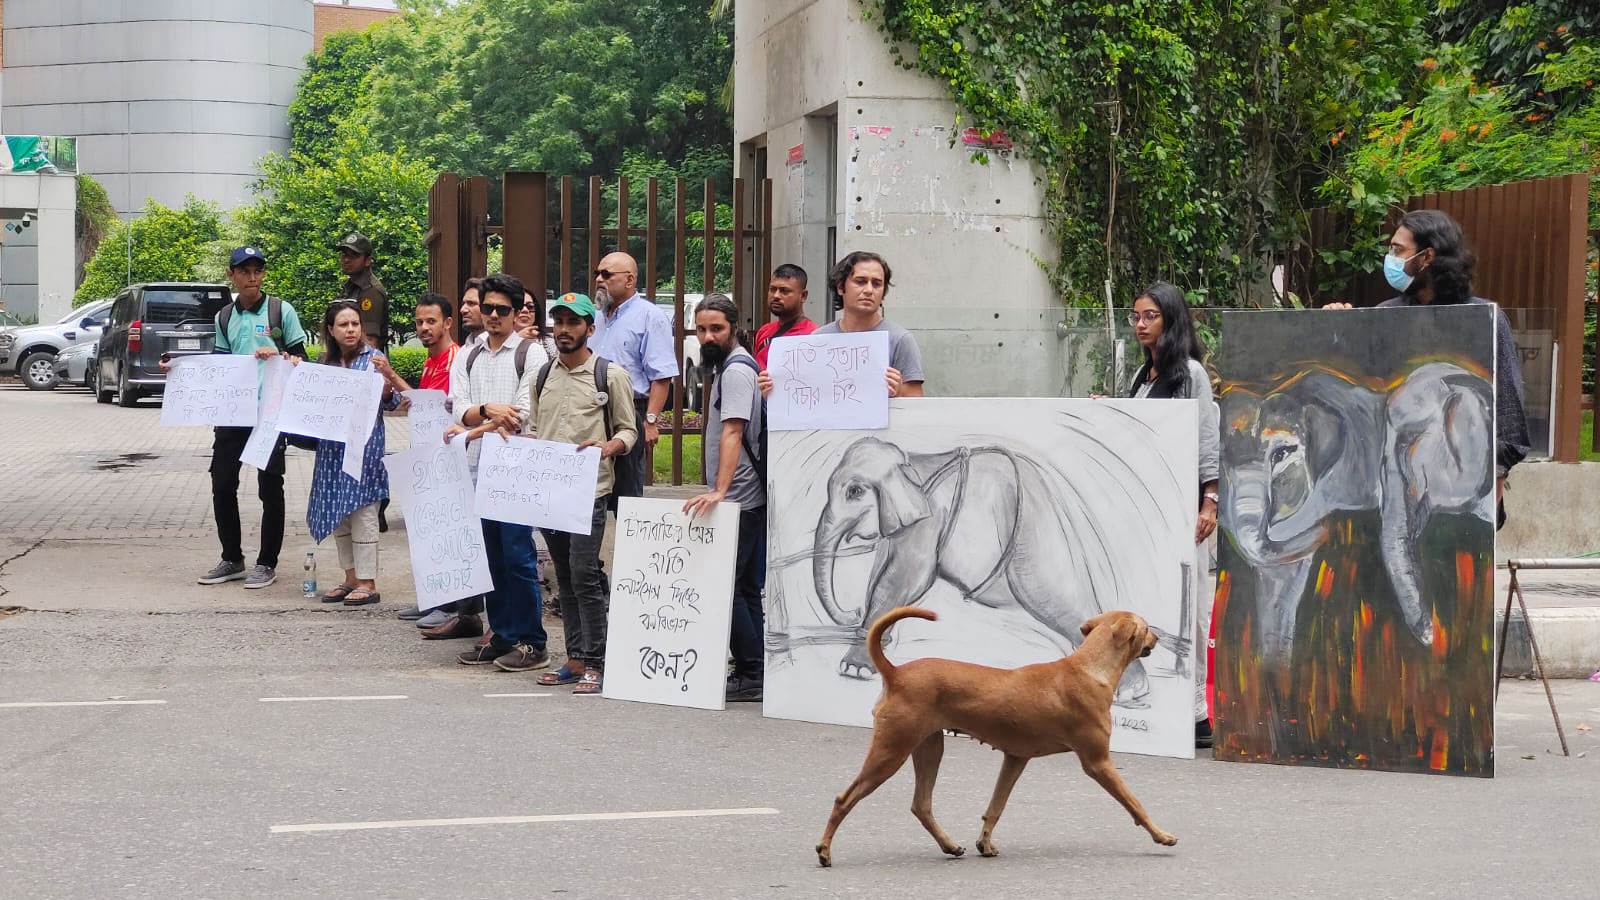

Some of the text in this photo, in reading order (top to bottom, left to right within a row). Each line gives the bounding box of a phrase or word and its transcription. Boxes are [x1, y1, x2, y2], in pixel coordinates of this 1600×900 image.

[784, 378, 863, 416] বিচার চাই
[495, 445, 522, 463] বনের
[527, 446, 559, 465] হাতি
[624, 511, 683, 544] চাঁদাবাজির
[648, 546, 691, 575] হাতি
[639, 646, 698, 692] কেন?
